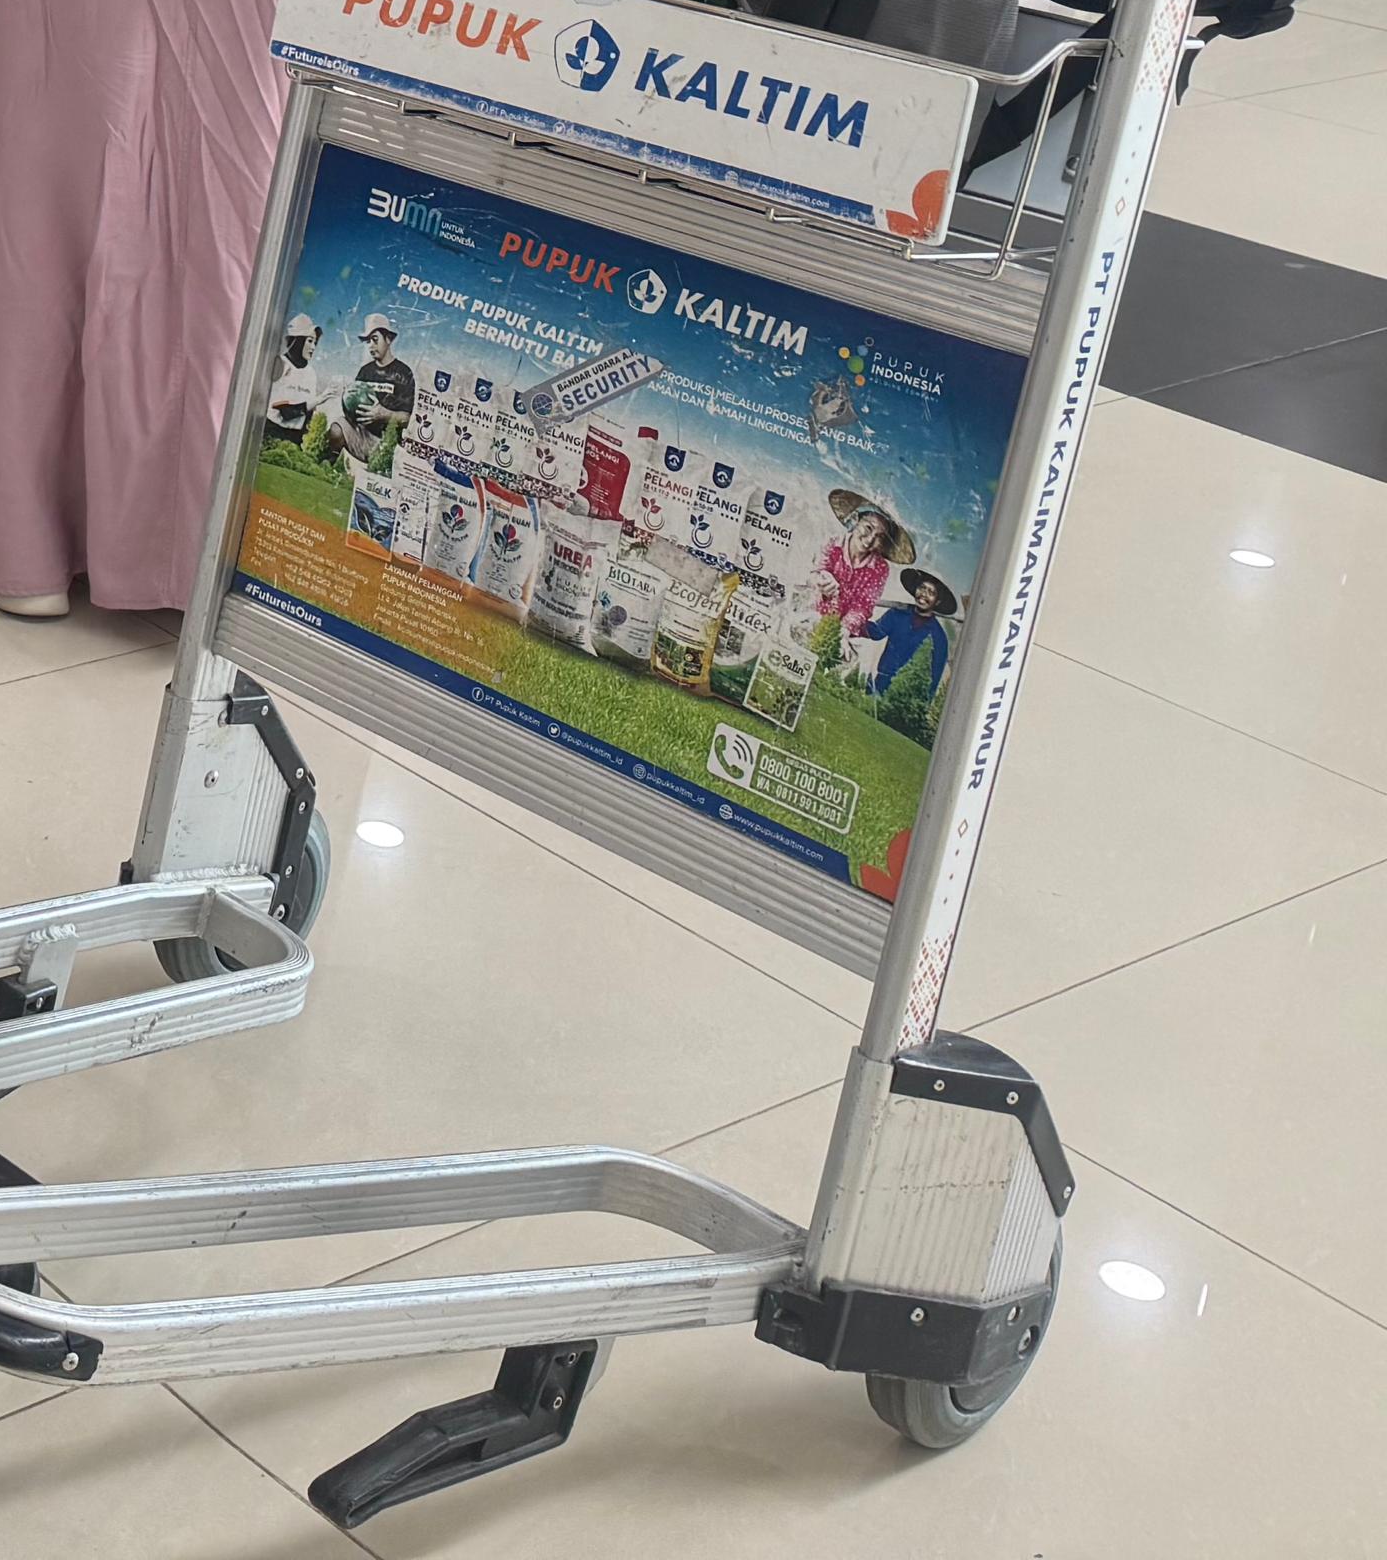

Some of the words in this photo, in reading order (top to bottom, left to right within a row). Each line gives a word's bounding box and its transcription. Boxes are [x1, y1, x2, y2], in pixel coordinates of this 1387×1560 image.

[634, 47, 870, 149] KALTIM
[439, 229, 476, 249] INDONESIA
[440, 221, 466, 236] UNTUK
[1093, 249, 1116, 296] PT
[498, 232, 621, 293] PUPUK
[673, 288, 809, 357] KALTIM
[397, 273, 470, 311] PRODUK
[470, 298, 532, 333] PUPUK
[533, 319, 604, 357] KALTIM
[464, 317, 549, 360] BERMUTU
[552, 348, 588, 371] BA
[556, 370, 591, 393] BANDAR
[592, 355, 621, 376] UDARA
[561, 354, 652, 411] SECURITY
[870, 363, 942, 396] INDONESIA
[873, 351, 946, 384] PUPUK
[1056, 306, 1102, 431] PUPUK
[417, 393, 455, 413] PELANG
[646, 380, 680, 402] AMAN
[681, 391, 705, 409] DAN
[747, 415, 817, 447] LINGKUNGA
[659, 369, 715, 398] PRODUKSI
[715, 389, 765, 413] MELALUI
[764, 406, 811, 431] PROSES
[817, 425, 846, 443] ANG
[495, 414, 535, 438] PELANG
[544, 429, 585, 449] ELANGI
[643, 471, 694, 499] PELANGI
[287, 519, 310, 534] PUSAT
[743, 514, 793, 542] PELANGI
[553, 541, 593, 569] UREA
[997, 439, 1068, 671] KALIMANTAN
[382, 572, 407, 589] PUPUK
[407, 583, 447, 607] INDONESIA
[384, 562, 418, 583] LAYANAN
[418, 577, 464, 602] PELANGGAN
[667, 579, 722, 613] Ecofert
[245, 582, 323, 627] #FutureisOurs
[484, 693, 495, 704] PT
[495, 698, 518, 717] Pupuk
[517, 709, 542, 727] Kaltim
[966, 677, 1008, 792] TIMUR
[646, 771, 706, 805] pupukkaltim_id
[756, 775, 771, 790] WA
[759, 755, 791, 781] 0800
[793, 770, 817, 791] 100
[818, 780, 849, 809] 8001
[733, 811, 824, 862] www.pupukkaltim.com
